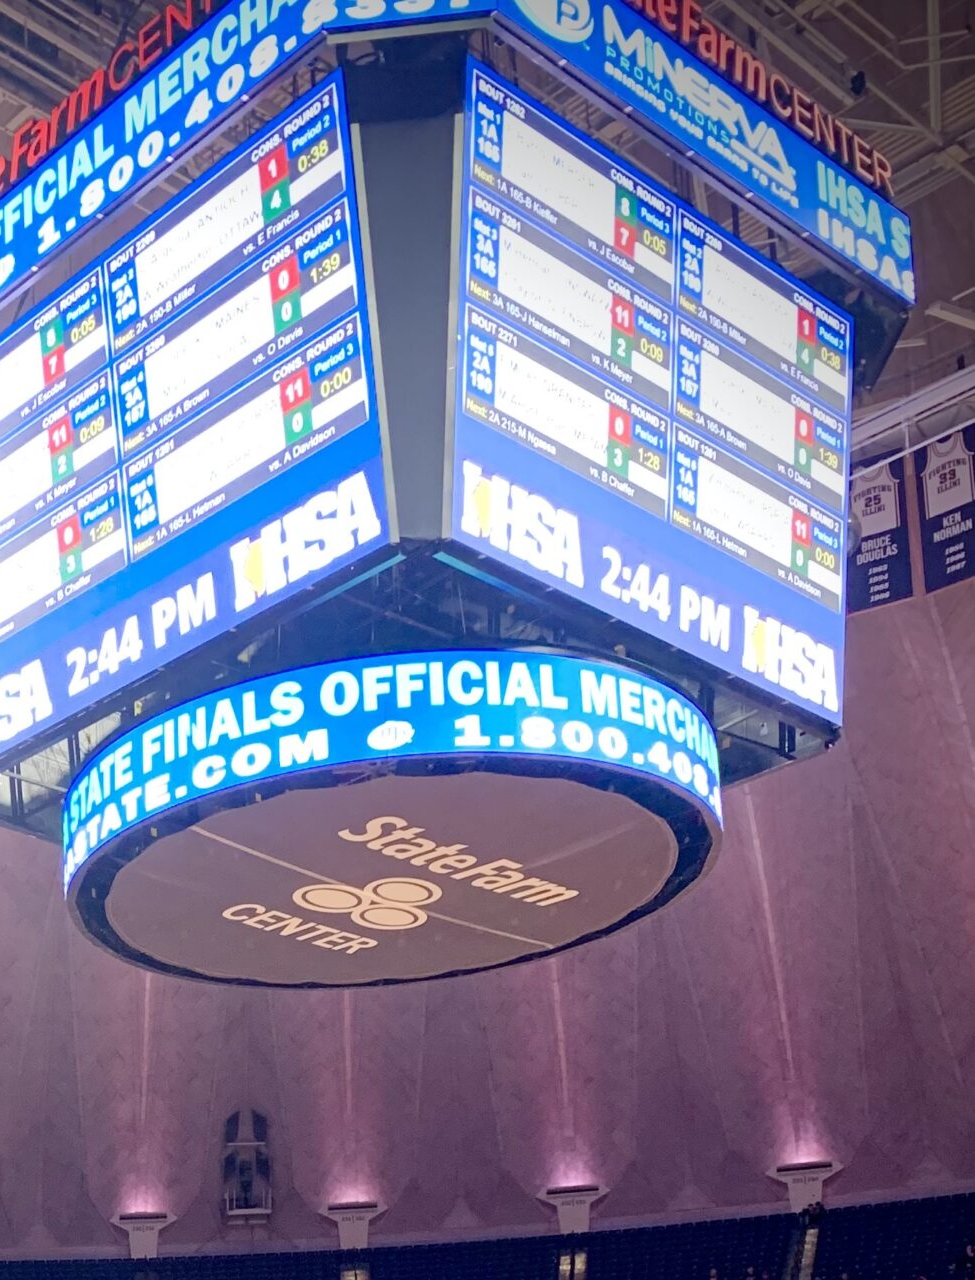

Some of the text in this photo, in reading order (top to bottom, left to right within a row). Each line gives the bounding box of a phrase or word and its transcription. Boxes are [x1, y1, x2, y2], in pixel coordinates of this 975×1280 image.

[284, 102, 322, 135] ROUND
[268, 115, 331, 178] 1 Period 2
[770, 73, 895, 198] CENTER
[297, 139, 330, 173] 0:38
[270, 190, 282, 209] 4
[620, 197, 663, 229] 8 Period
[817, 160, 886, 246] IHSA
[266, 209, 300, 240] Francis
[294, 215, 332, 248] ROUND
[620, 228, 630, 246] 7
[643, 230, 667, 256] 0:05
[278, 236, 334, 290] 0 Period
[309, 253, 341, 285] 1:39
[281, 300, 293, 321] 0
[615, 305, 630, 328] 11
[70, 315, 96, 343] 0:05
[277, 326, 303, 351] Davis
[306, 329, 342, 362] ROUND
[616, 338, 664, 363] 2 0:09
[285, 342, 354, 404] 11 Period 3
[320, 367, 352, 399] 0:00
[79, 415, 105, 443] 0:09
[292, 411, 304, 433] 0
[292, 426, 336, 457] Davidson
[638, 447, 661, 472] 1:28
[864, 493, 882, 510] 25
[933, 518, 973, 544] NORMAN
[942, 510, 962, 529] KEN
[856, 544, 899, 566] DOUGLAS
[861, 533, 892, 553] BRUCE
[601, 546, 672, 623] 2:44
[679, 583, 731, 653] PM
[66, 615, 144, 698] 2:44
[152, 571, 217, 650] PM
[70, 740, 133, 835] STATE
[142, 676, 306, 775] FINALS
[319, 658, 569, 718] OFFICIAL
[222, 903, 379, 955] CENTER
